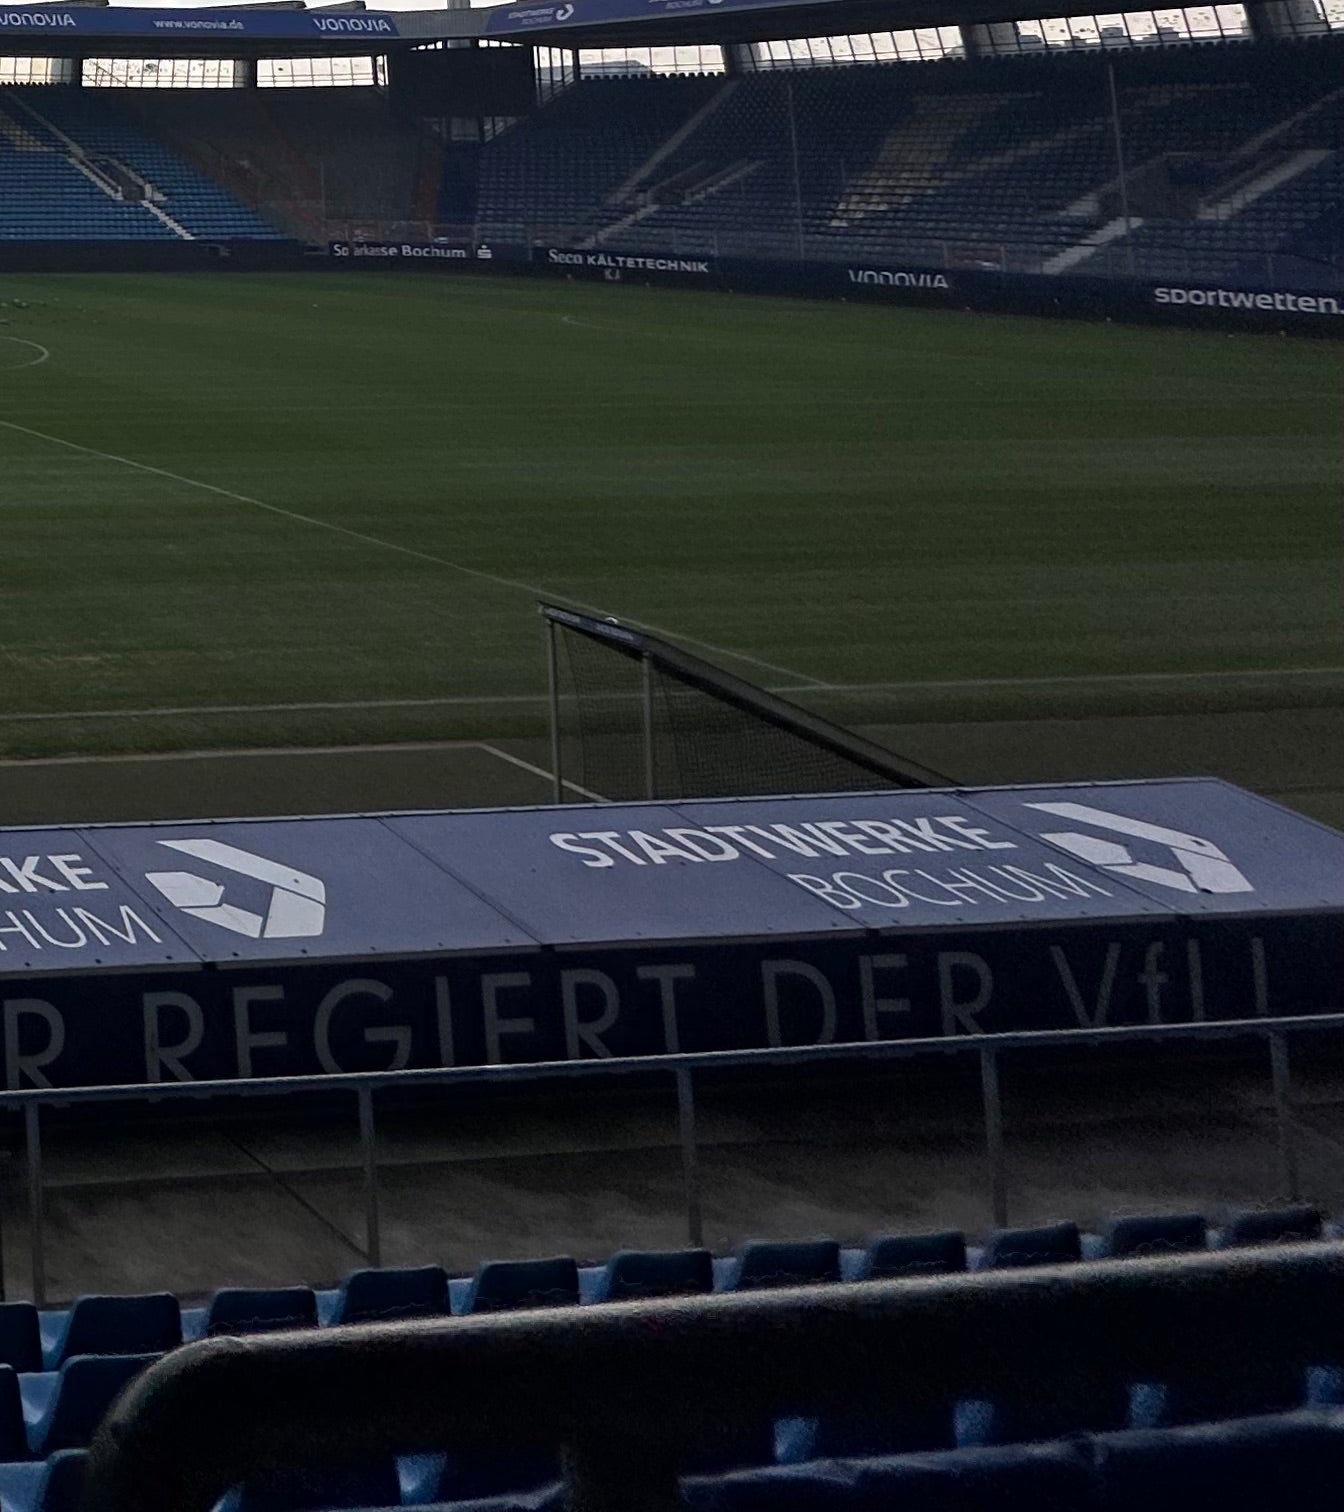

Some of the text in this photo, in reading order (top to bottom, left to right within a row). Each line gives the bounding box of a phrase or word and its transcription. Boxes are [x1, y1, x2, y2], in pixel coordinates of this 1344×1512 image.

[401, 244, 467, 258] Bochum
[587, 253, 709, 273] KÄLTETECHNIK
[549, 815, 1018, 868] STADTWERKE
[787, 862, 1113, 909] BOCHUM
[142, 963, 697, 1100] REGIERT
[760, 950, 994, 1056] DER
